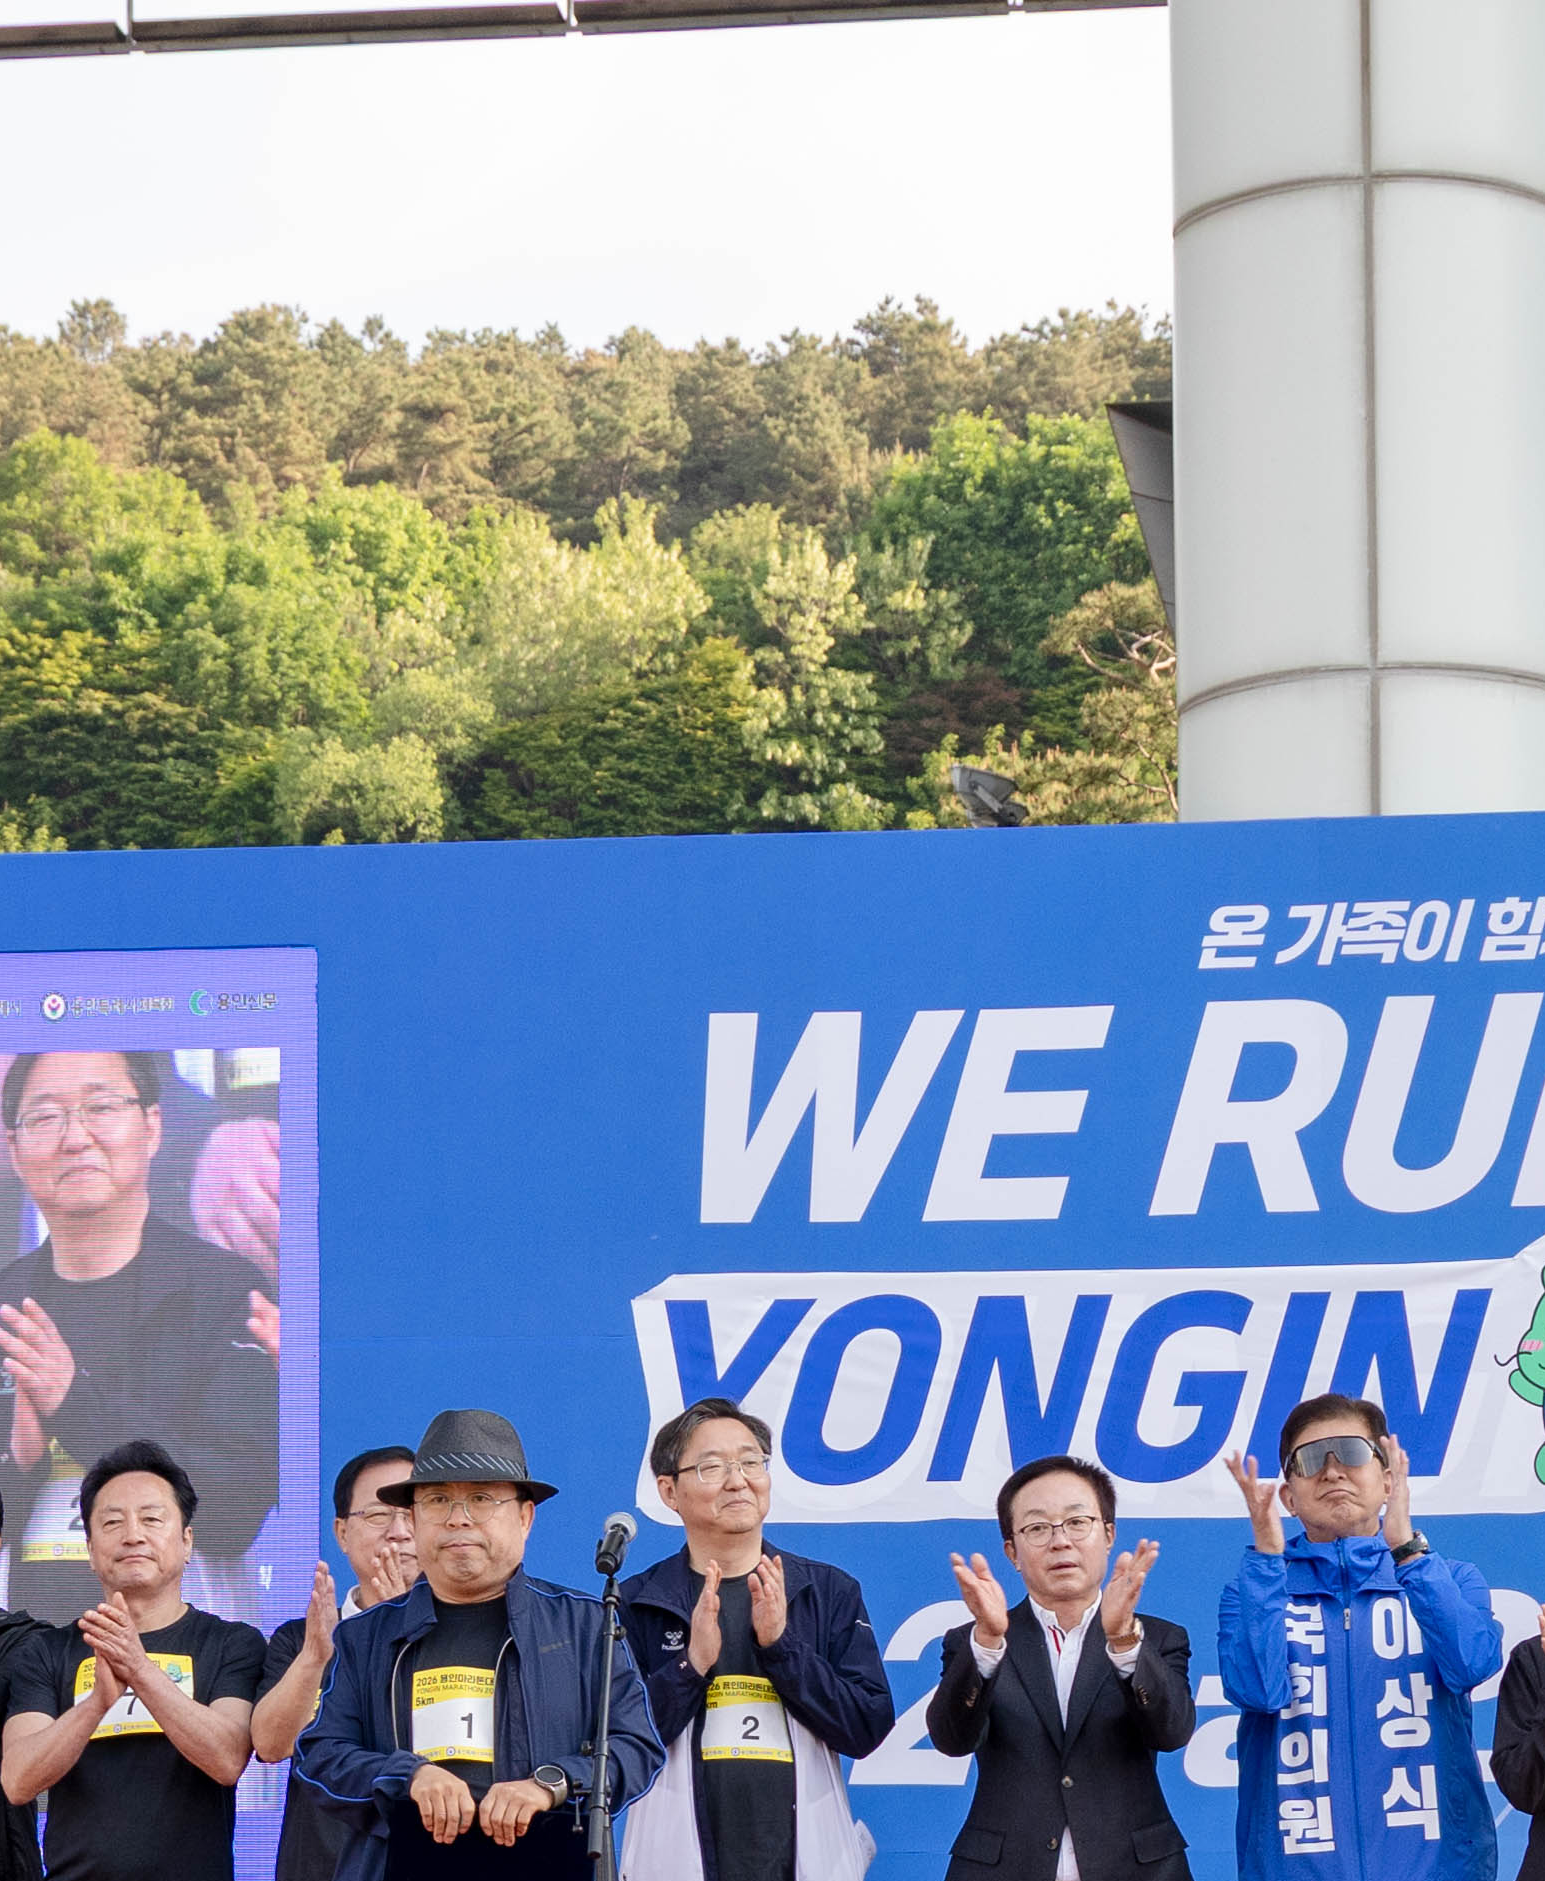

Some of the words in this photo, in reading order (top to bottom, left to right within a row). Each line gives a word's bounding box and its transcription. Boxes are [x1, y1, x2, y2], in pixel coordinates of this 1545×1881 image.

[1198, 905, 1267, 970] 온
[1275, 899, 1467, 964] 가족이
[700, 1005, 1115, 1223] WE
[664, 1288, 1492, 1487] YONGIN
[415, 1696, 435, 1707] 5km
[460, 1712, 473, 1739] 1
[741, 1715, 760, 1740] 2
[1277, 1602, 1336, 1856] 국회의원
[1372, 1597, 1441, 1840] 이상식
